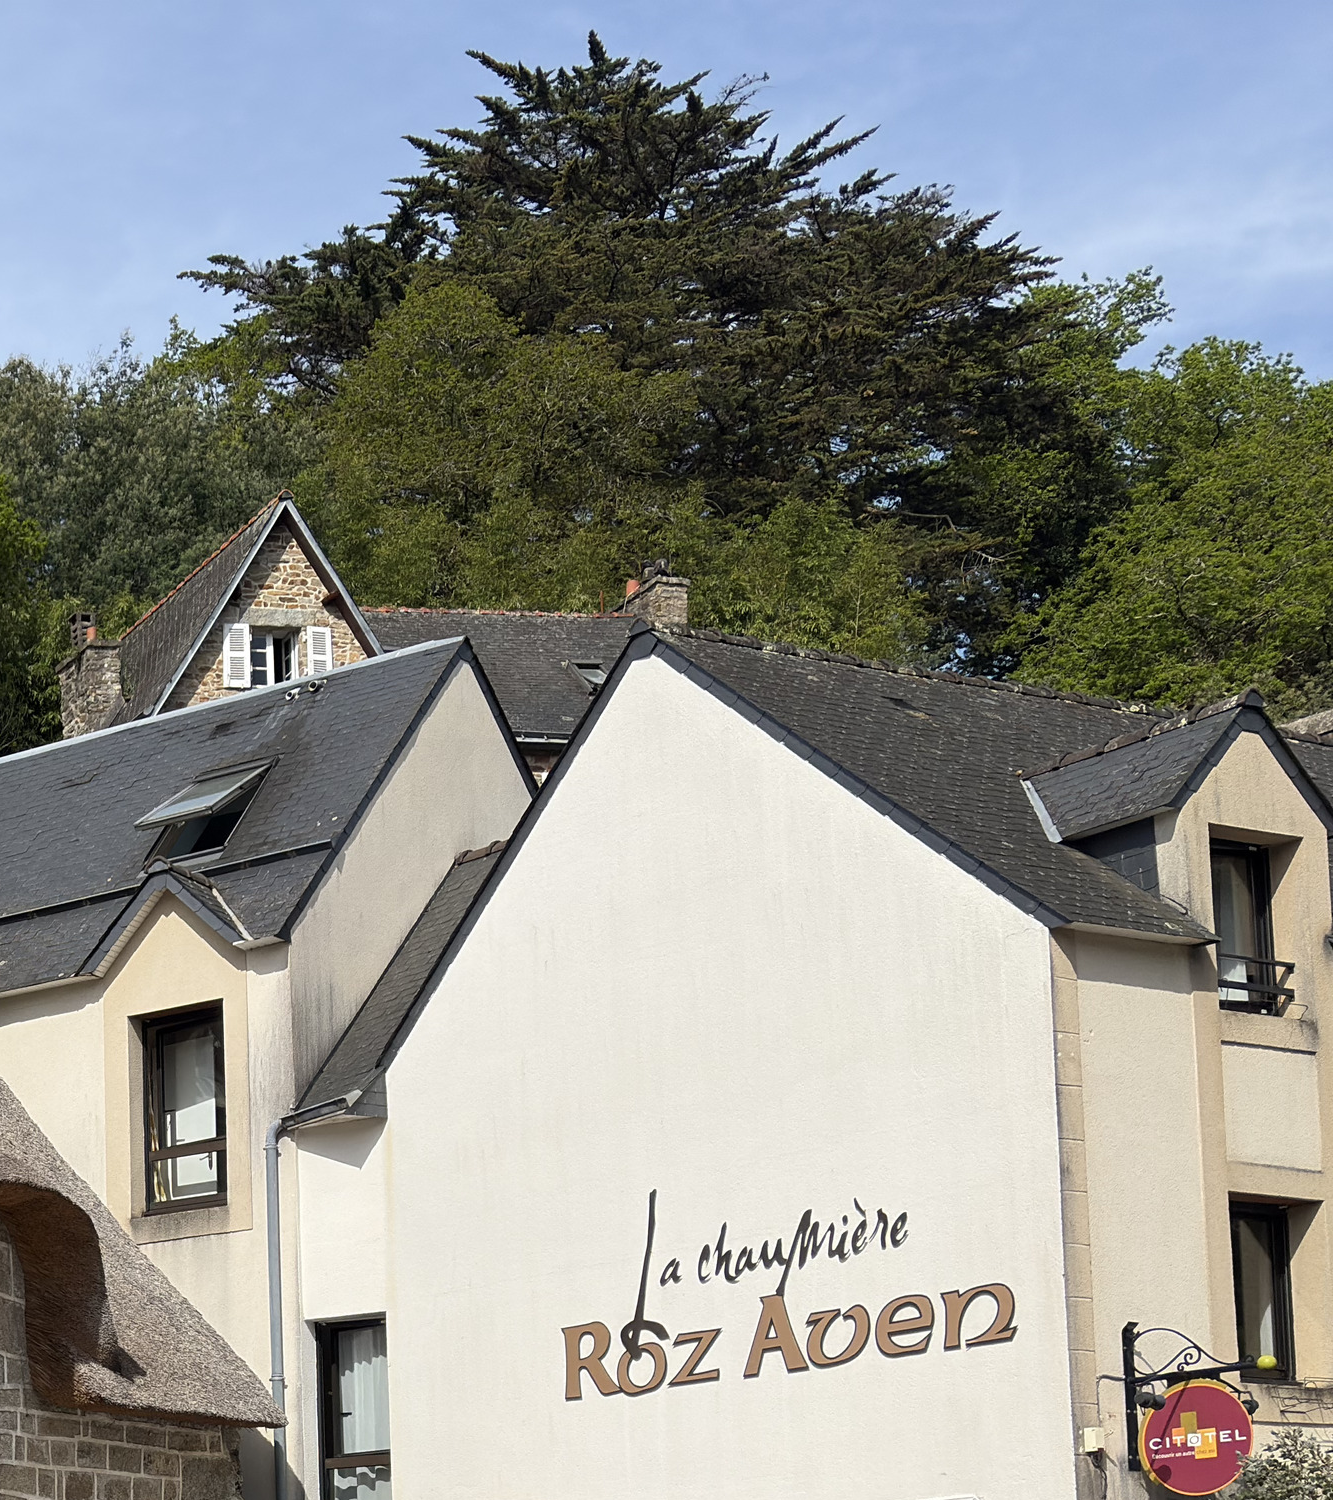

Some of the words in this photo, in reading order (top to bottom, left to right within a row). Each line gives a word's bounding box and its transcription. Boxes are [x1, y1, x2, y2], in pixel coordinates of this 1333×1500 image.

[620, 1188, 683, 1361] La
[696, 1197, 909, 1297] chaumière
[561, 1320, 723, 1402] Roz
[743, 1283, 1019, 1380] Aven
[1149, 1429, 1247, 1450] CITOTEL
